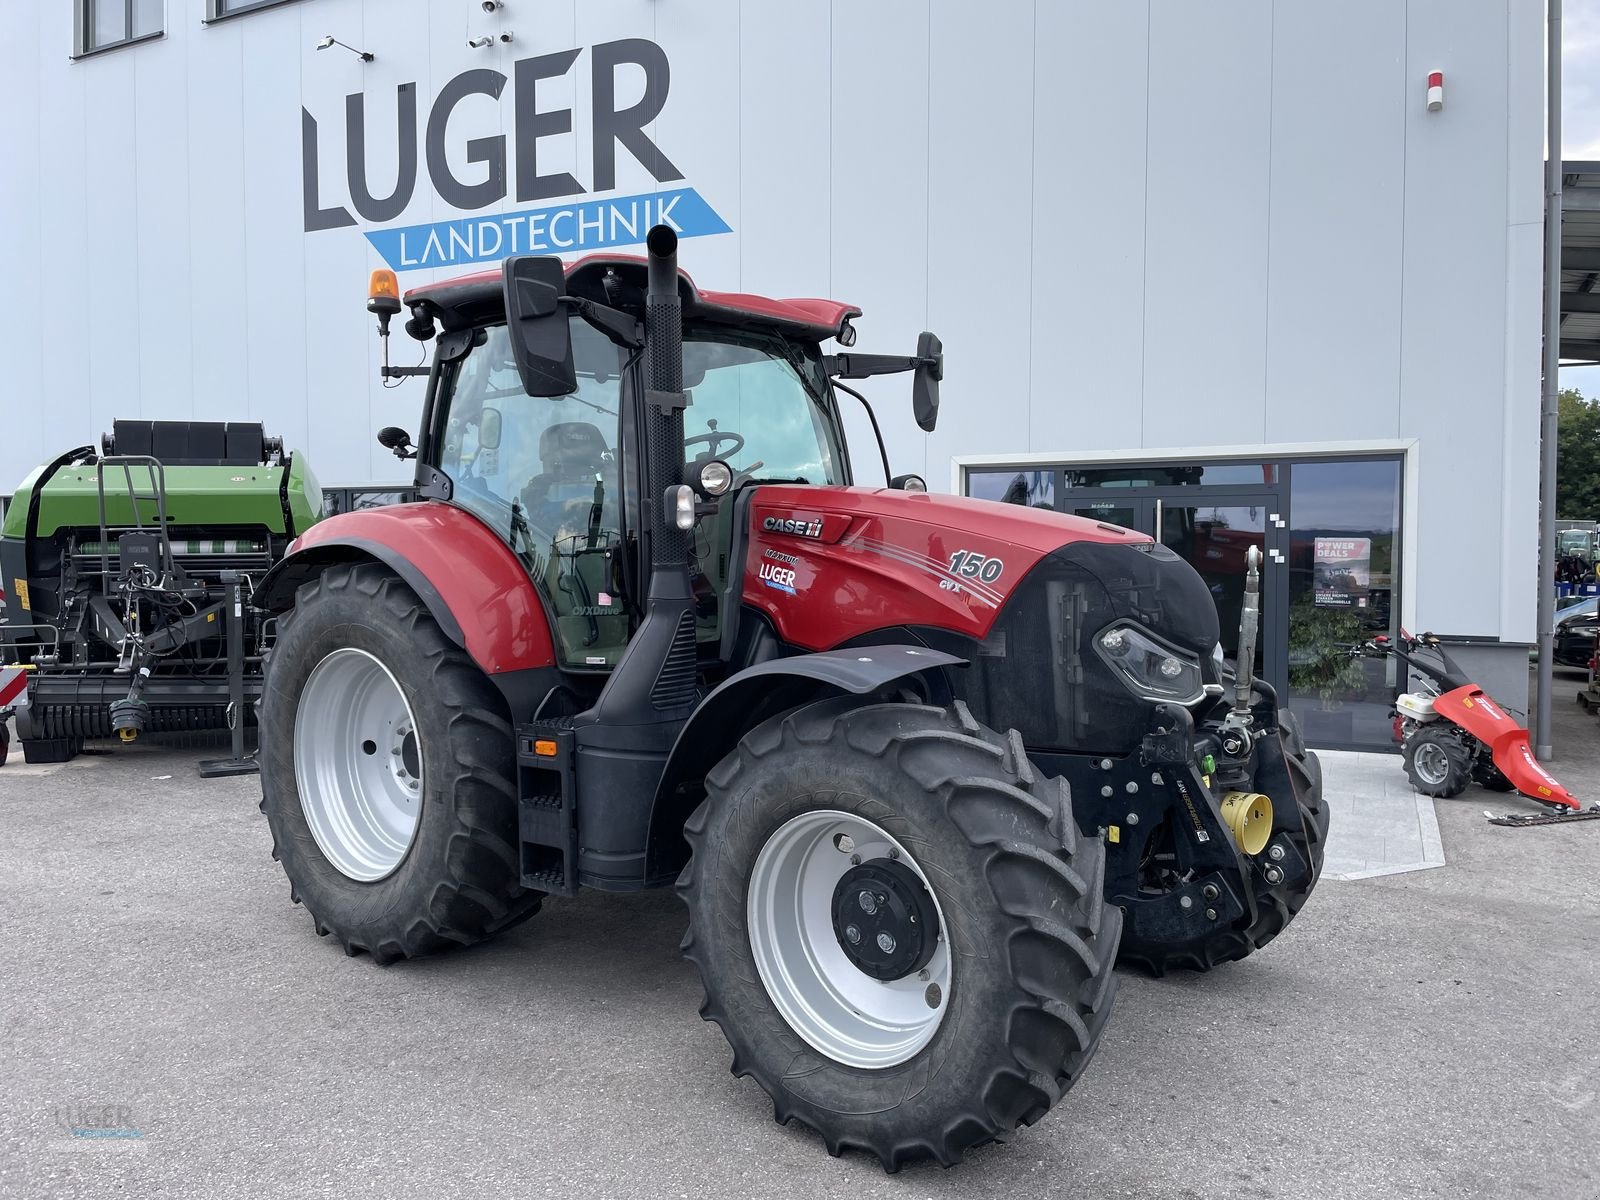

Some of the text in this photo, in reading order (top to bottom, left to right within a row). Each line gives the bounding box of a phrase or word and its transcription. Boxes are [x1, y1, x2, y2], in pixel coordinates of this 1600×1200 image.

[302, 38, 686, 233] LUGER
[399, 195, 684, 267] LANDTECHNIK
[763, 517, 806, 535] CASE
[764, 548, 799, 565] MAXXUM
[1317, 549, 1349, 557] DEALS
[758, 562, 796, 588] LUGER
[949, 549, 1004, 584] 150
[939, 579, 961, 593] CVX
[572, 606, 620, 616] CVXDrive
